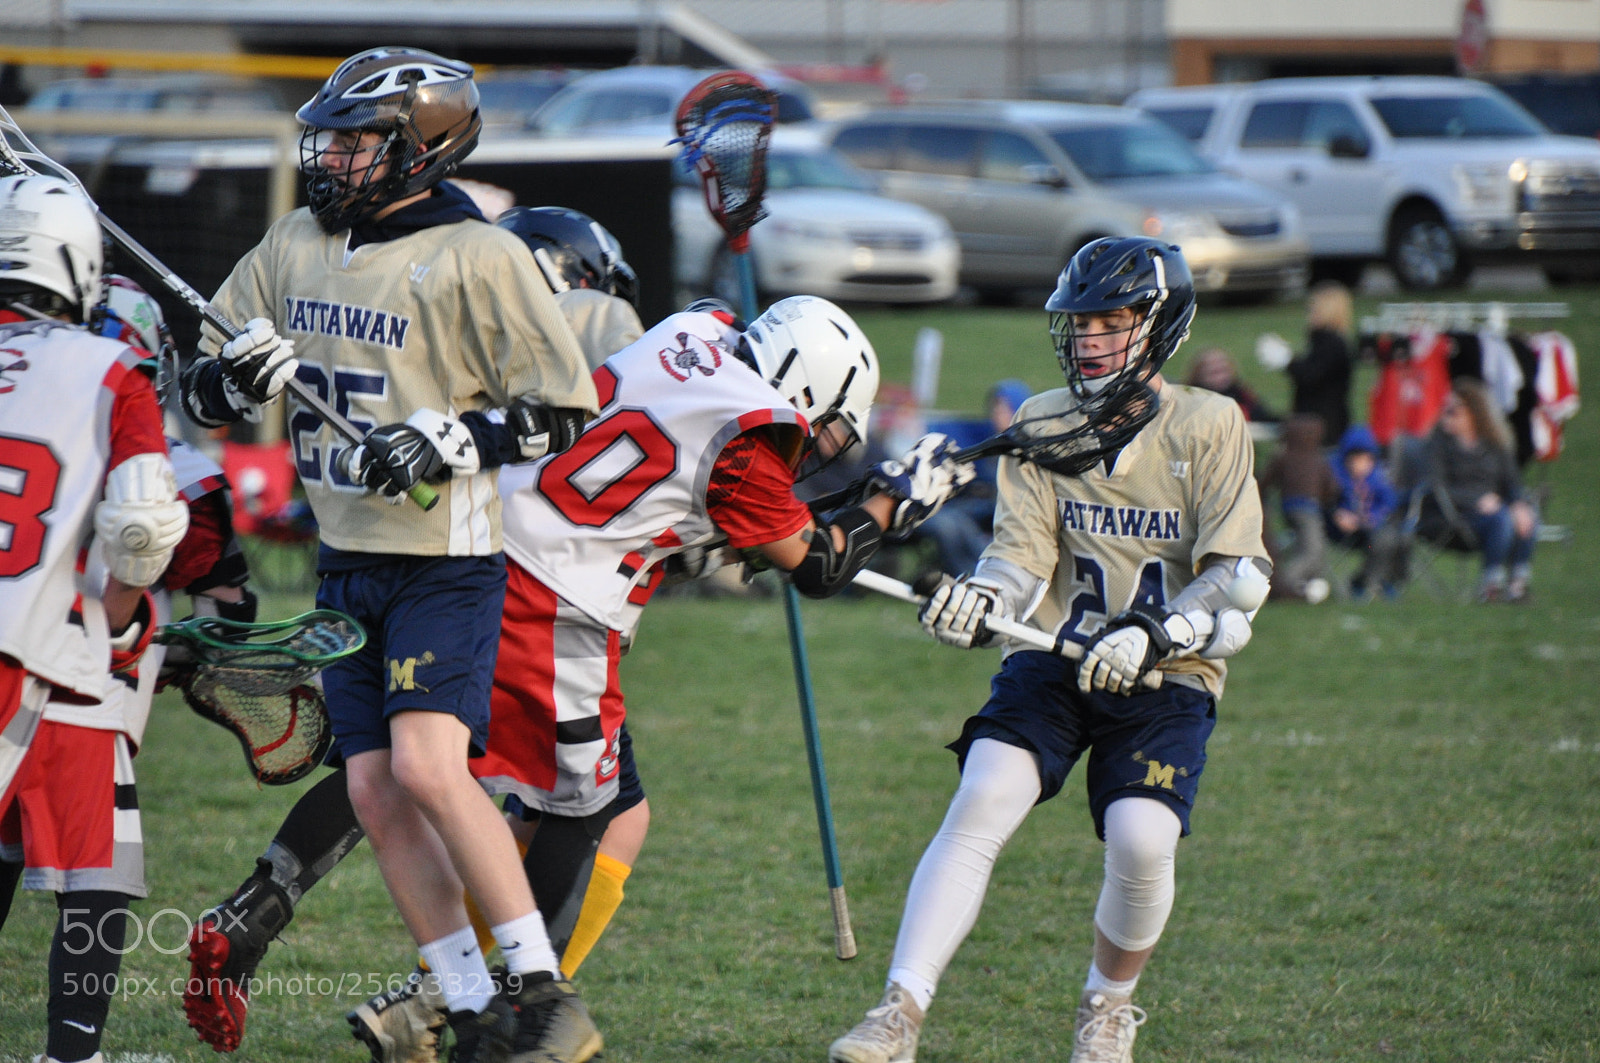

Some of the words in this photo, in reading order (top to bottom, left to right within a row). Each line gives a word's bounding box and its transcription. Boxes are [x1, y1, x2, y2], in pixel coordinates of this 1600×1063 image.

[288, 359, 388, 493] 25
[1056, 498, 1182, 541] ATTAWAN
[1053, 551, 1169, 648] 24
[389, 657, 417, 692] M
[1143, 760, 1176, 789] M
